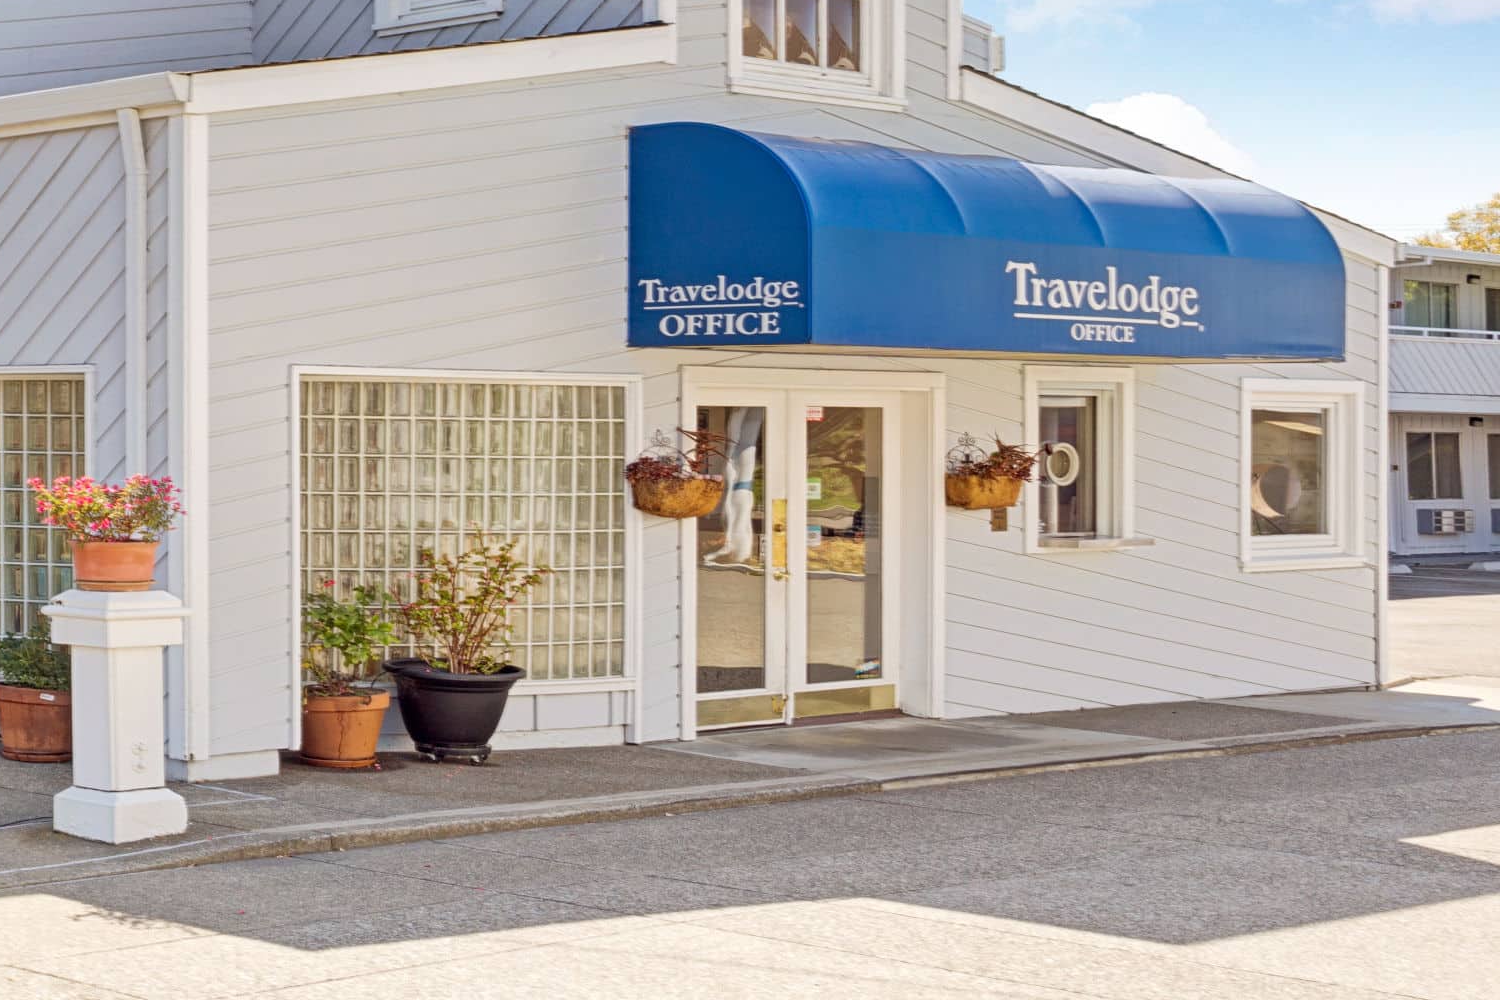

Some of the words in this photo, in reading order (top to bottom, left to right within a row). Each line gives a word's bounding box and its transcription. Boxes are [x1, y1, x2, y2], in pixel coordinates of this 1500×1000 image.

[638, 275, 799, 307] Travelodge
[1005, 260, 1199, 328] Travelodge
[659, 312, 780, 336] OFFICE
[1070, 323, 1135, 343] OFFICE
